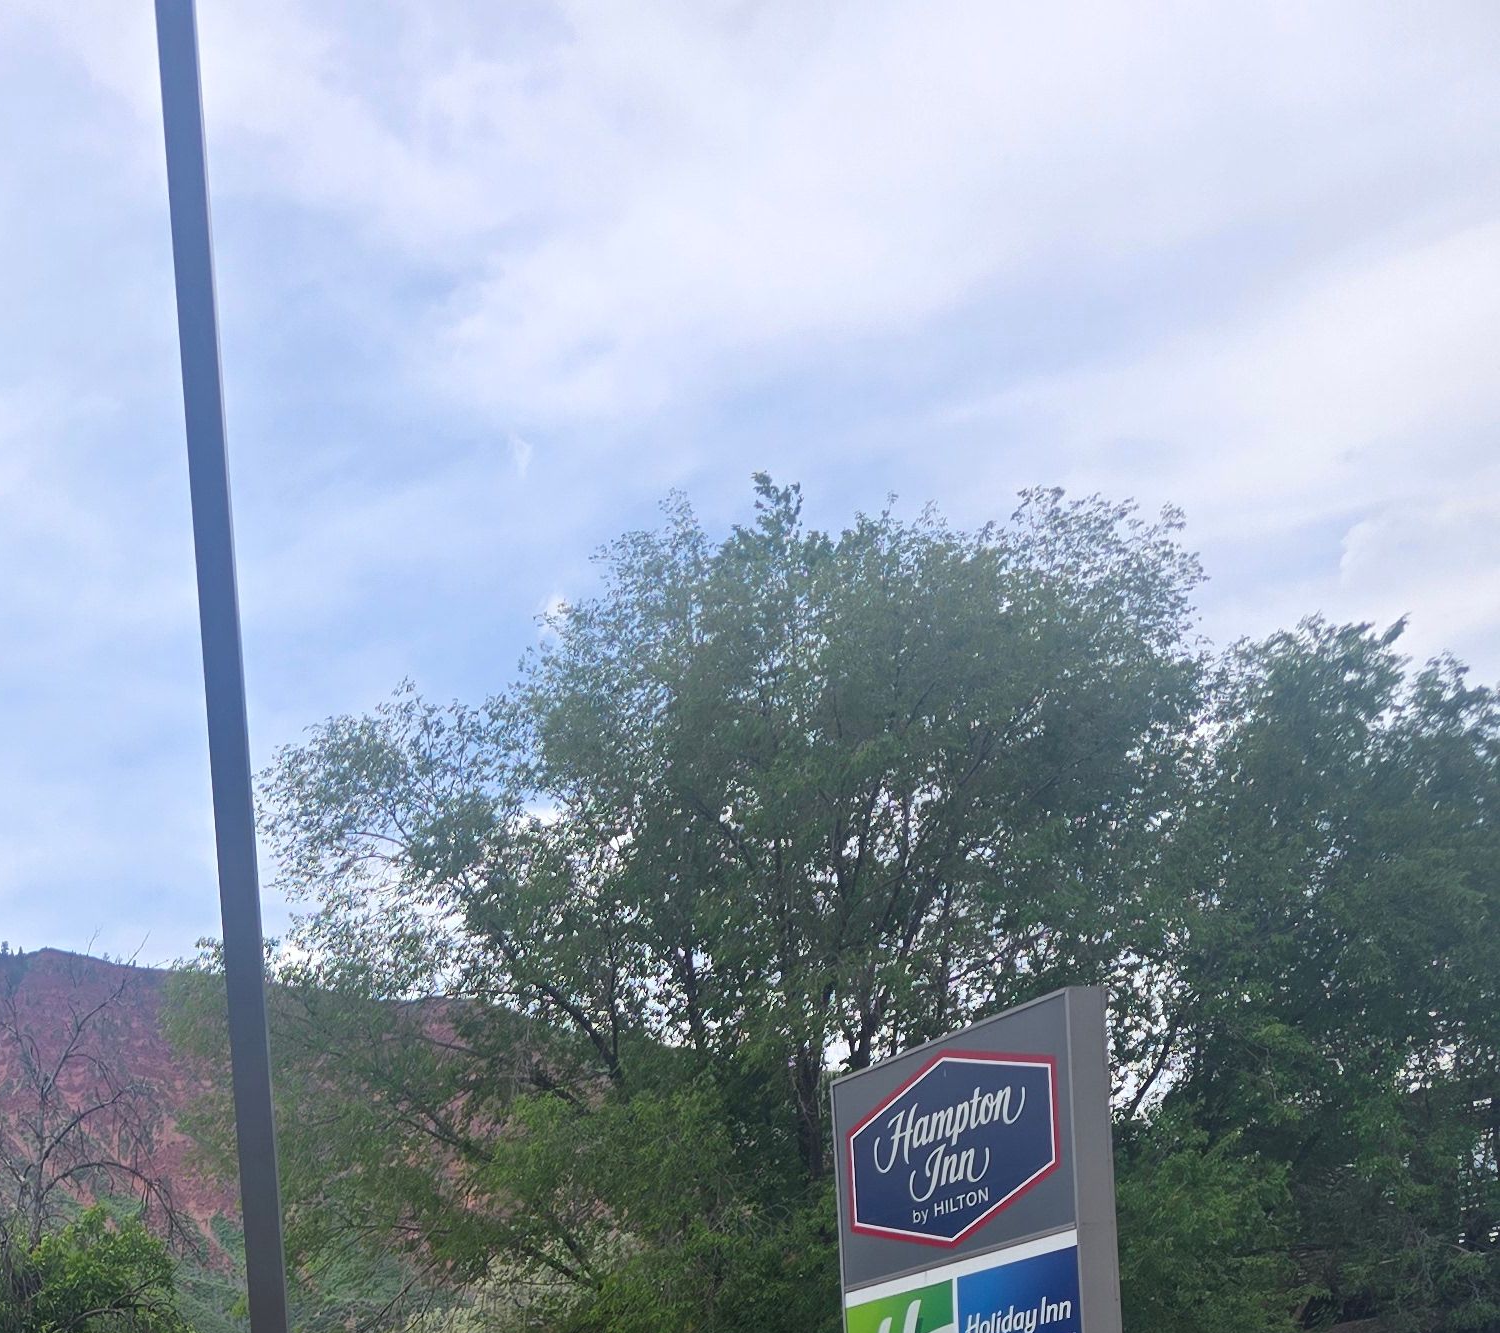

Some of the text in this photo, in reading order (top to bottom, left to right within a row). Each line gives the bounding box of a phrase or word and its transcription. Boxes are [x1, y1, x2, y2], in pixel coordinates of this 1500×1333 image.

[874, 1086, 1025, 1173] Hampton
[909, 1143, 989, 1202] Inn
[912, 1187, 989, 1225] by HILTON
[1040, 1296, 1072, 1325] Inn
